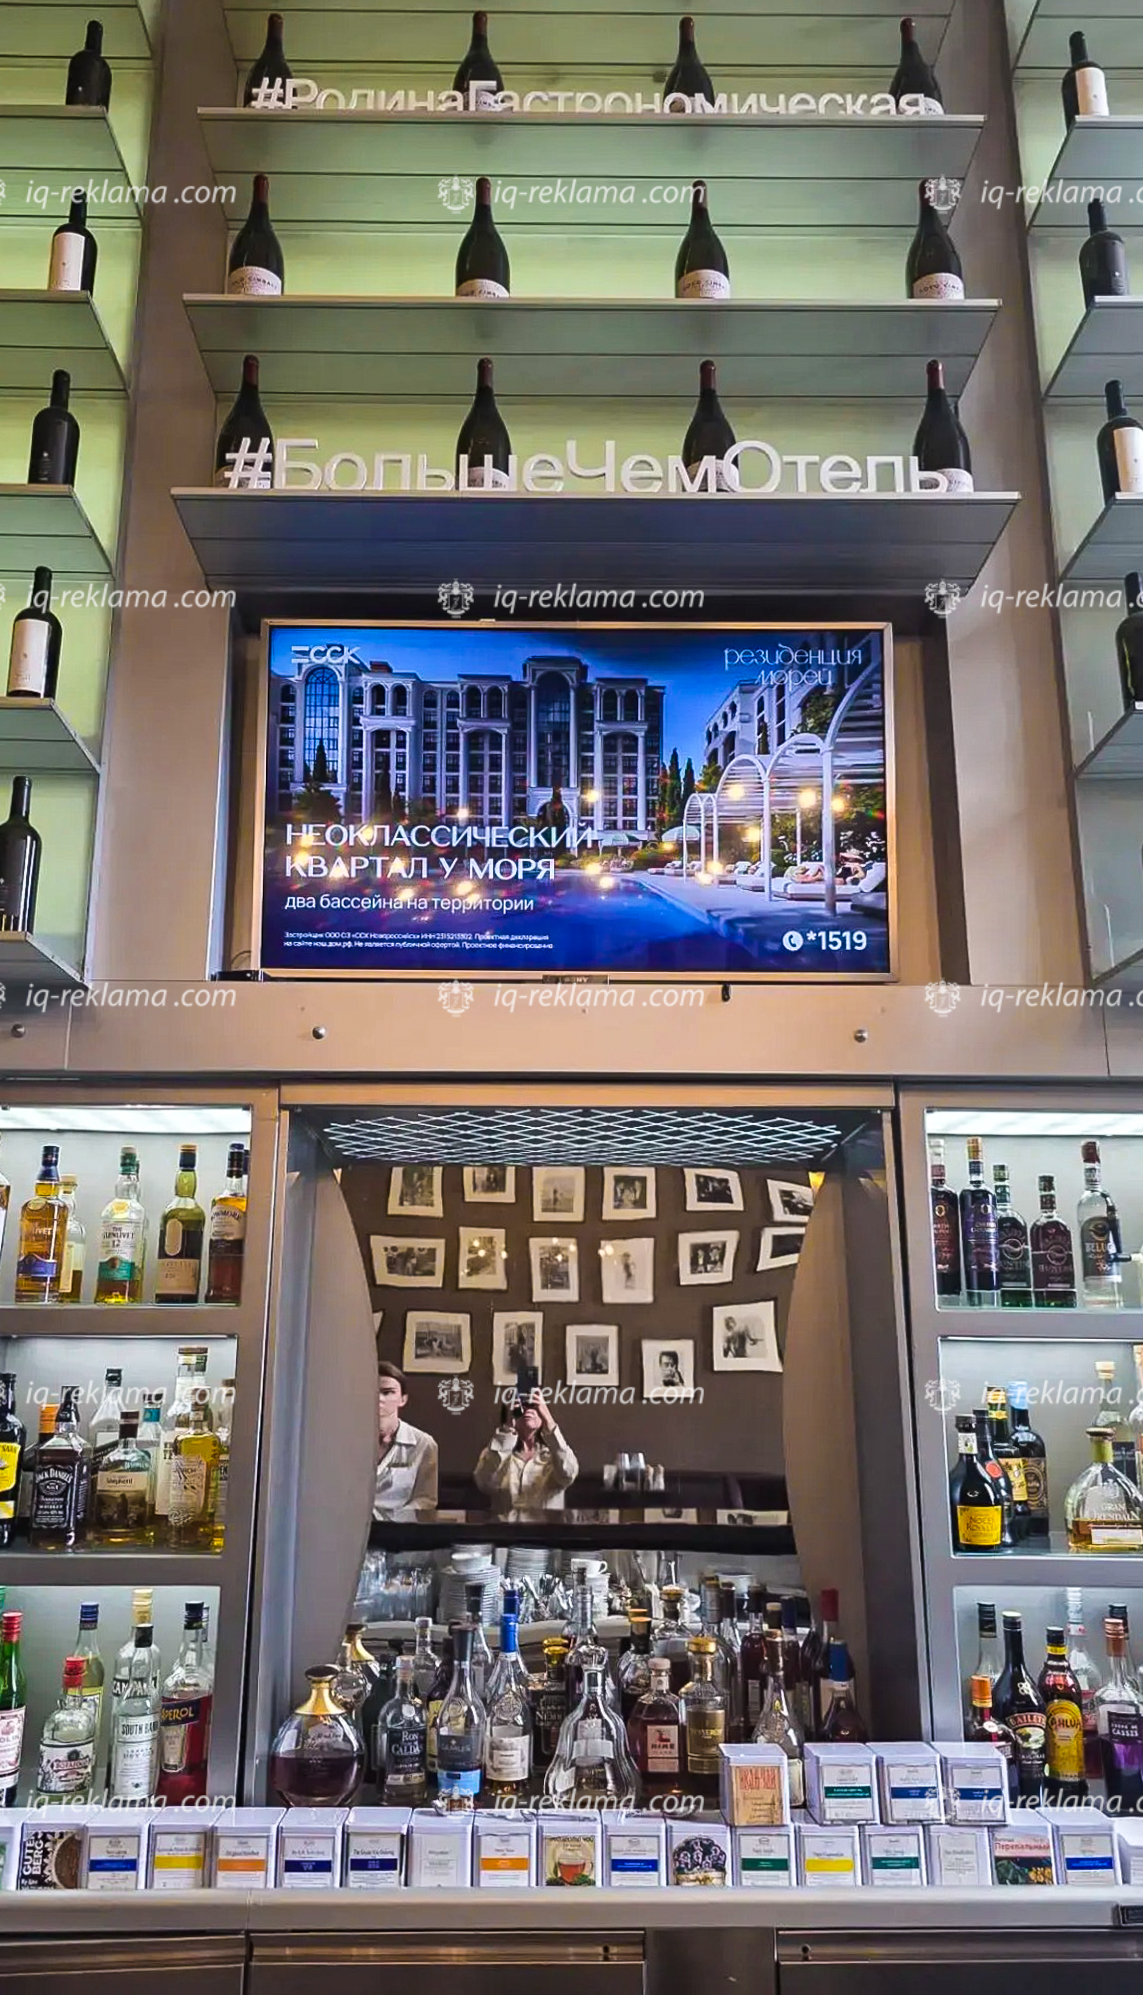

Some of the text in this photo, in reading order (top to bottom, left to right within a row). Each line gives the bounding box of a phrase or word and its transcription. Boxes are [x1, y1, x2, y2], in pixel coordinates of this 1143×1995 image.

[724, 644, 863, 670] резиденция
[755, 664, 833, 687] морей
[285, 820, 594, 849] НЕОКЛАССИЧЕСКИЙ
[285, 855, 555, 880] КВАРТАЛ У МОРЯ
[285, 893, 534, 913] два бассейна на территории
